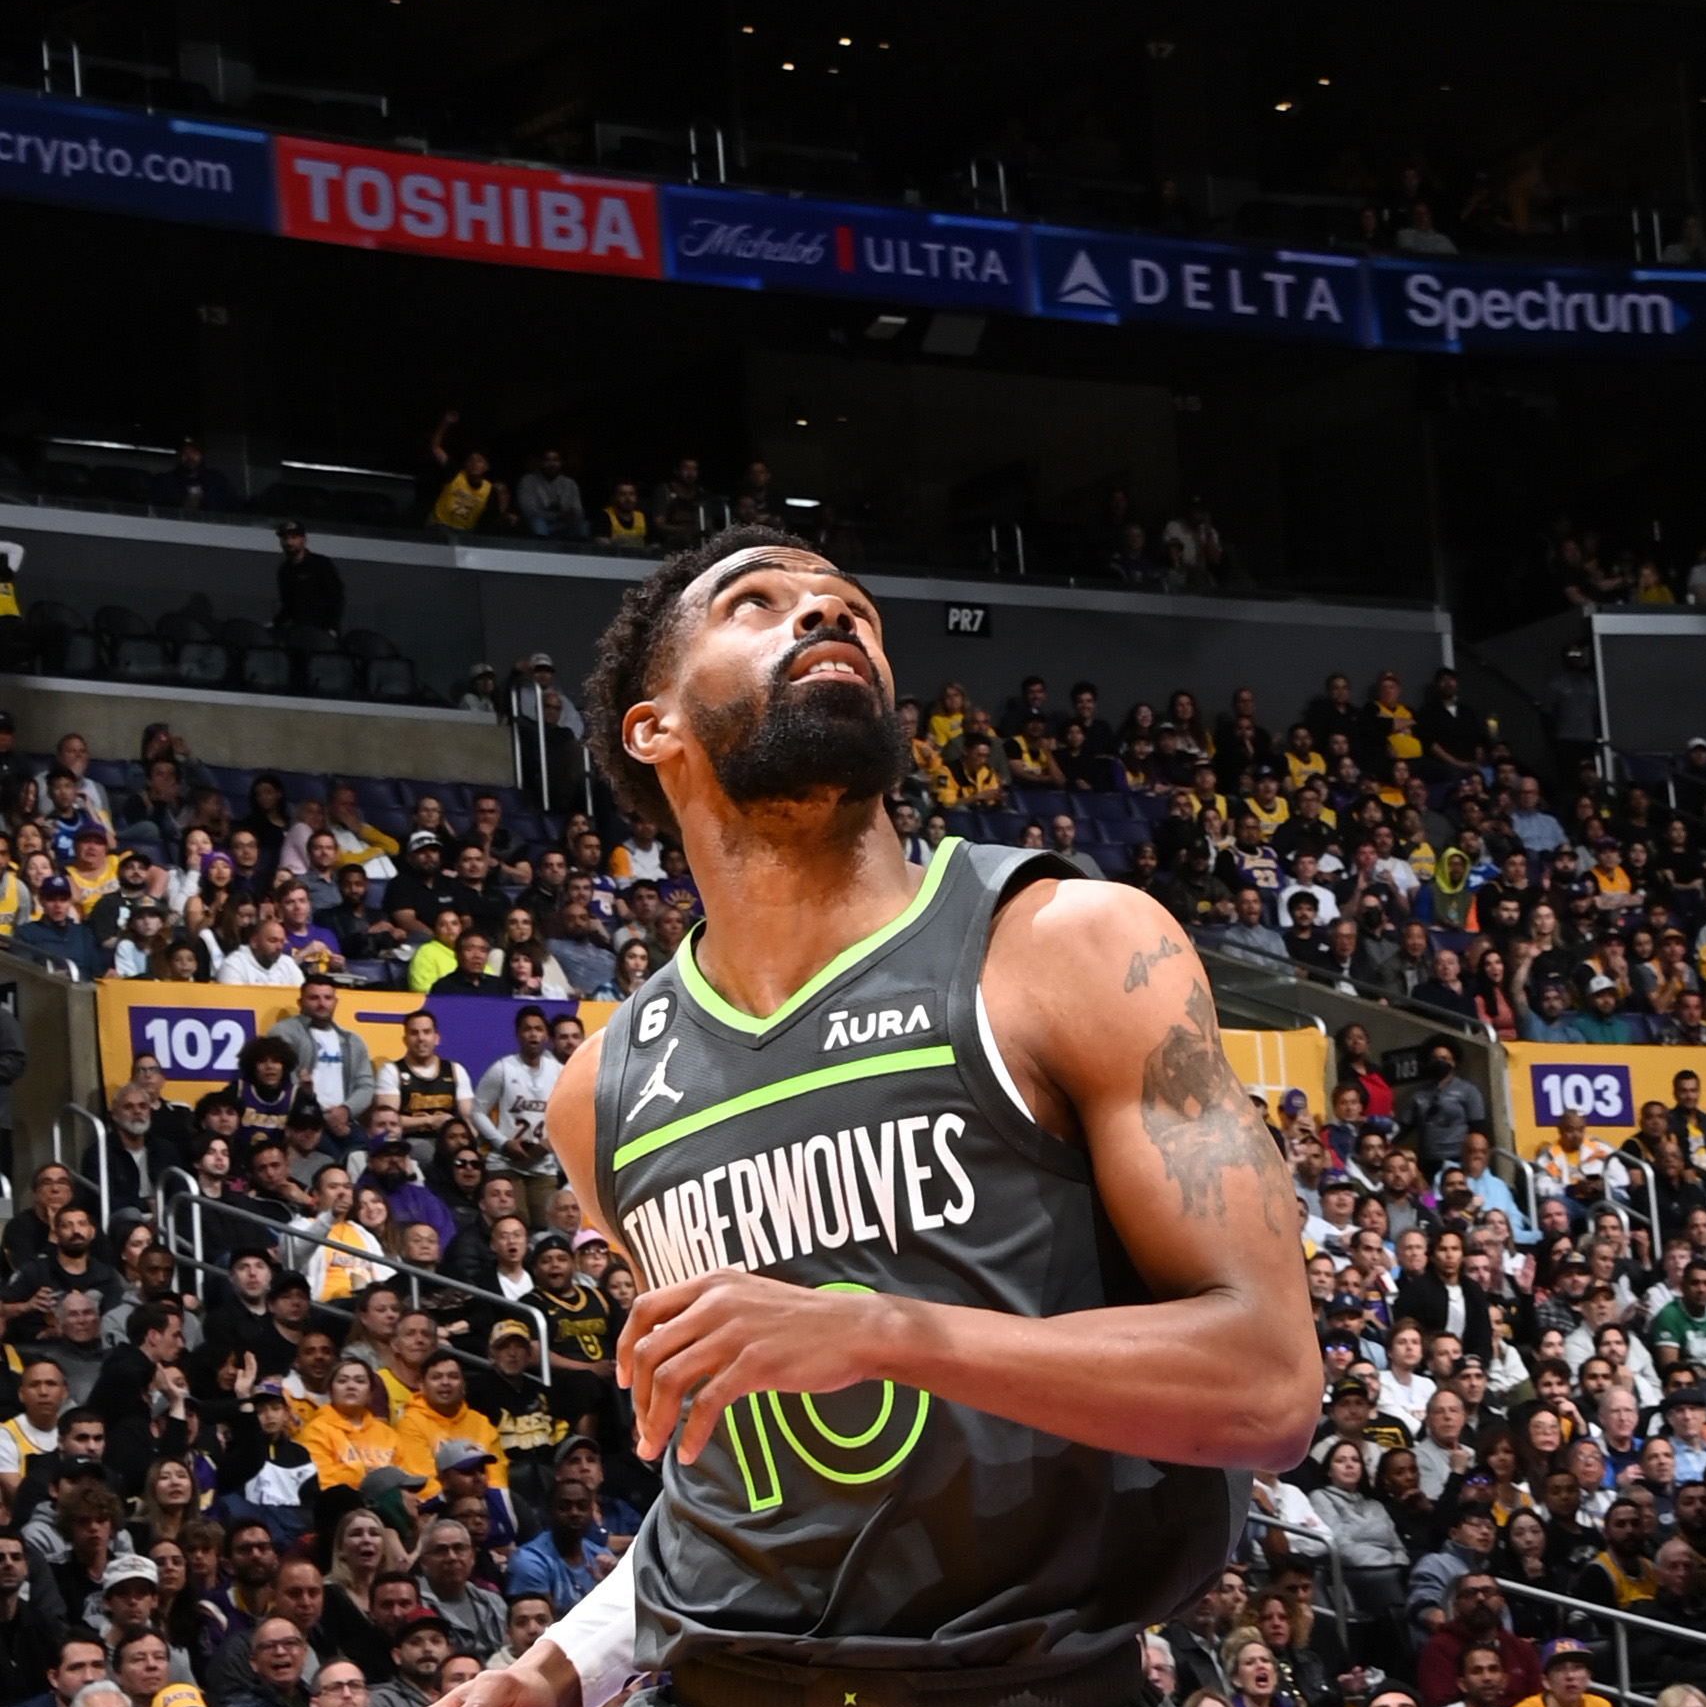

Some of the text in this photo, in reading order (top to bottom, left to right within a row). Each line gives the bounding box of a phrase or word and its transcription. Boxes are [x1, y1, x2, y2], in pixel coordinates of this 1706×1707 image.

[0, 129, 234, 194] crypto.com
[292, 157, 644, 261] TOSHIBA
[863, 235, 1011, 287] ULTRA
[1129, 258, 1344, 326] DELTA
[1406, 274, 1676, 341] Spectrum
[948, 608, 983, 632] PR7
[144, 1016, 248, 1071] 102
[638, 997, 670, 1042] 6
[1541, 1072, 1624, 1118] 103
